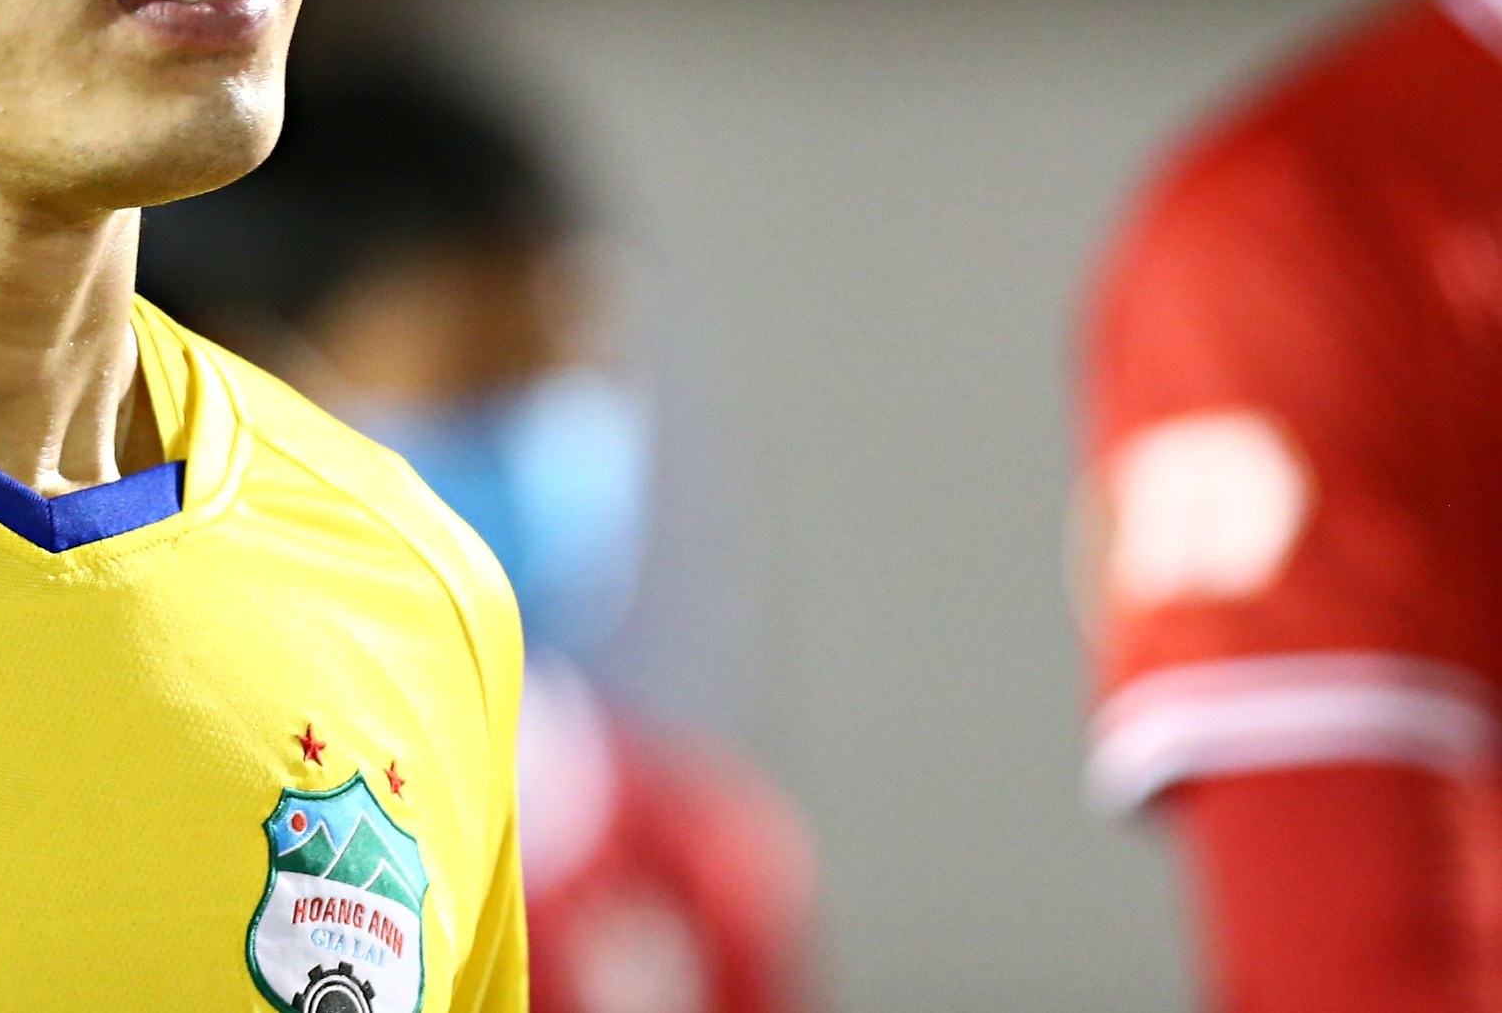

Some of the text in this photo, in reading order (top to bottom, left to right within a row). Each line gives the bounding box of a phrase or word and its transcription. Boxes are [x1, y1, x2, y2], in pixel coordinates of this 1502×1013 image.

[292, 897, 404, 959] HOANG ANH
[310, 928, 387, 966] GIA LAI
